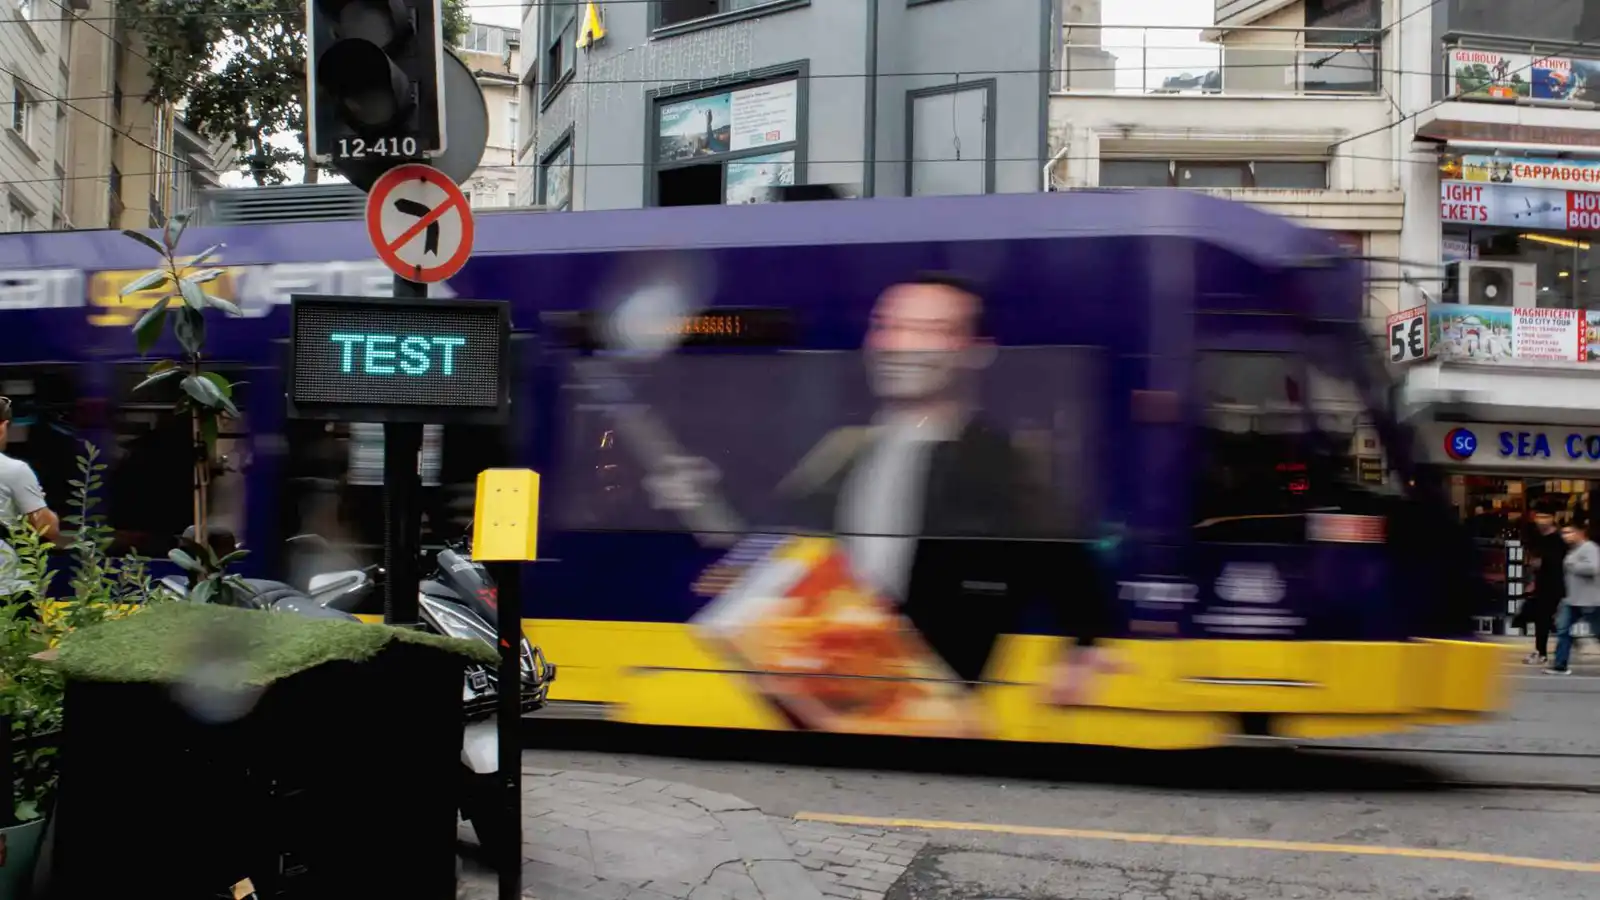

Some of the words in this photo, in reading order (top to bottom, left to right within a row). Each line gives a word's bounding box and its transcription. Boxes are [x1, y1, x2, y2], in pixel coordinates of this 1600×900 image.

[1455, 51, 1497, 64] GELIBOLU
[338, 136, 417, 158] 12-410
[1514, 308, 1576, 319] MAGNIFICENT
[1391, 316, 1425, 362] 5€
[330, 333, 466, 377] TEST
[1455, 436, 1473, 450] SC
[1499, 431, 1551, 457] SEA
[1566, 433, 1600, 459] CO
